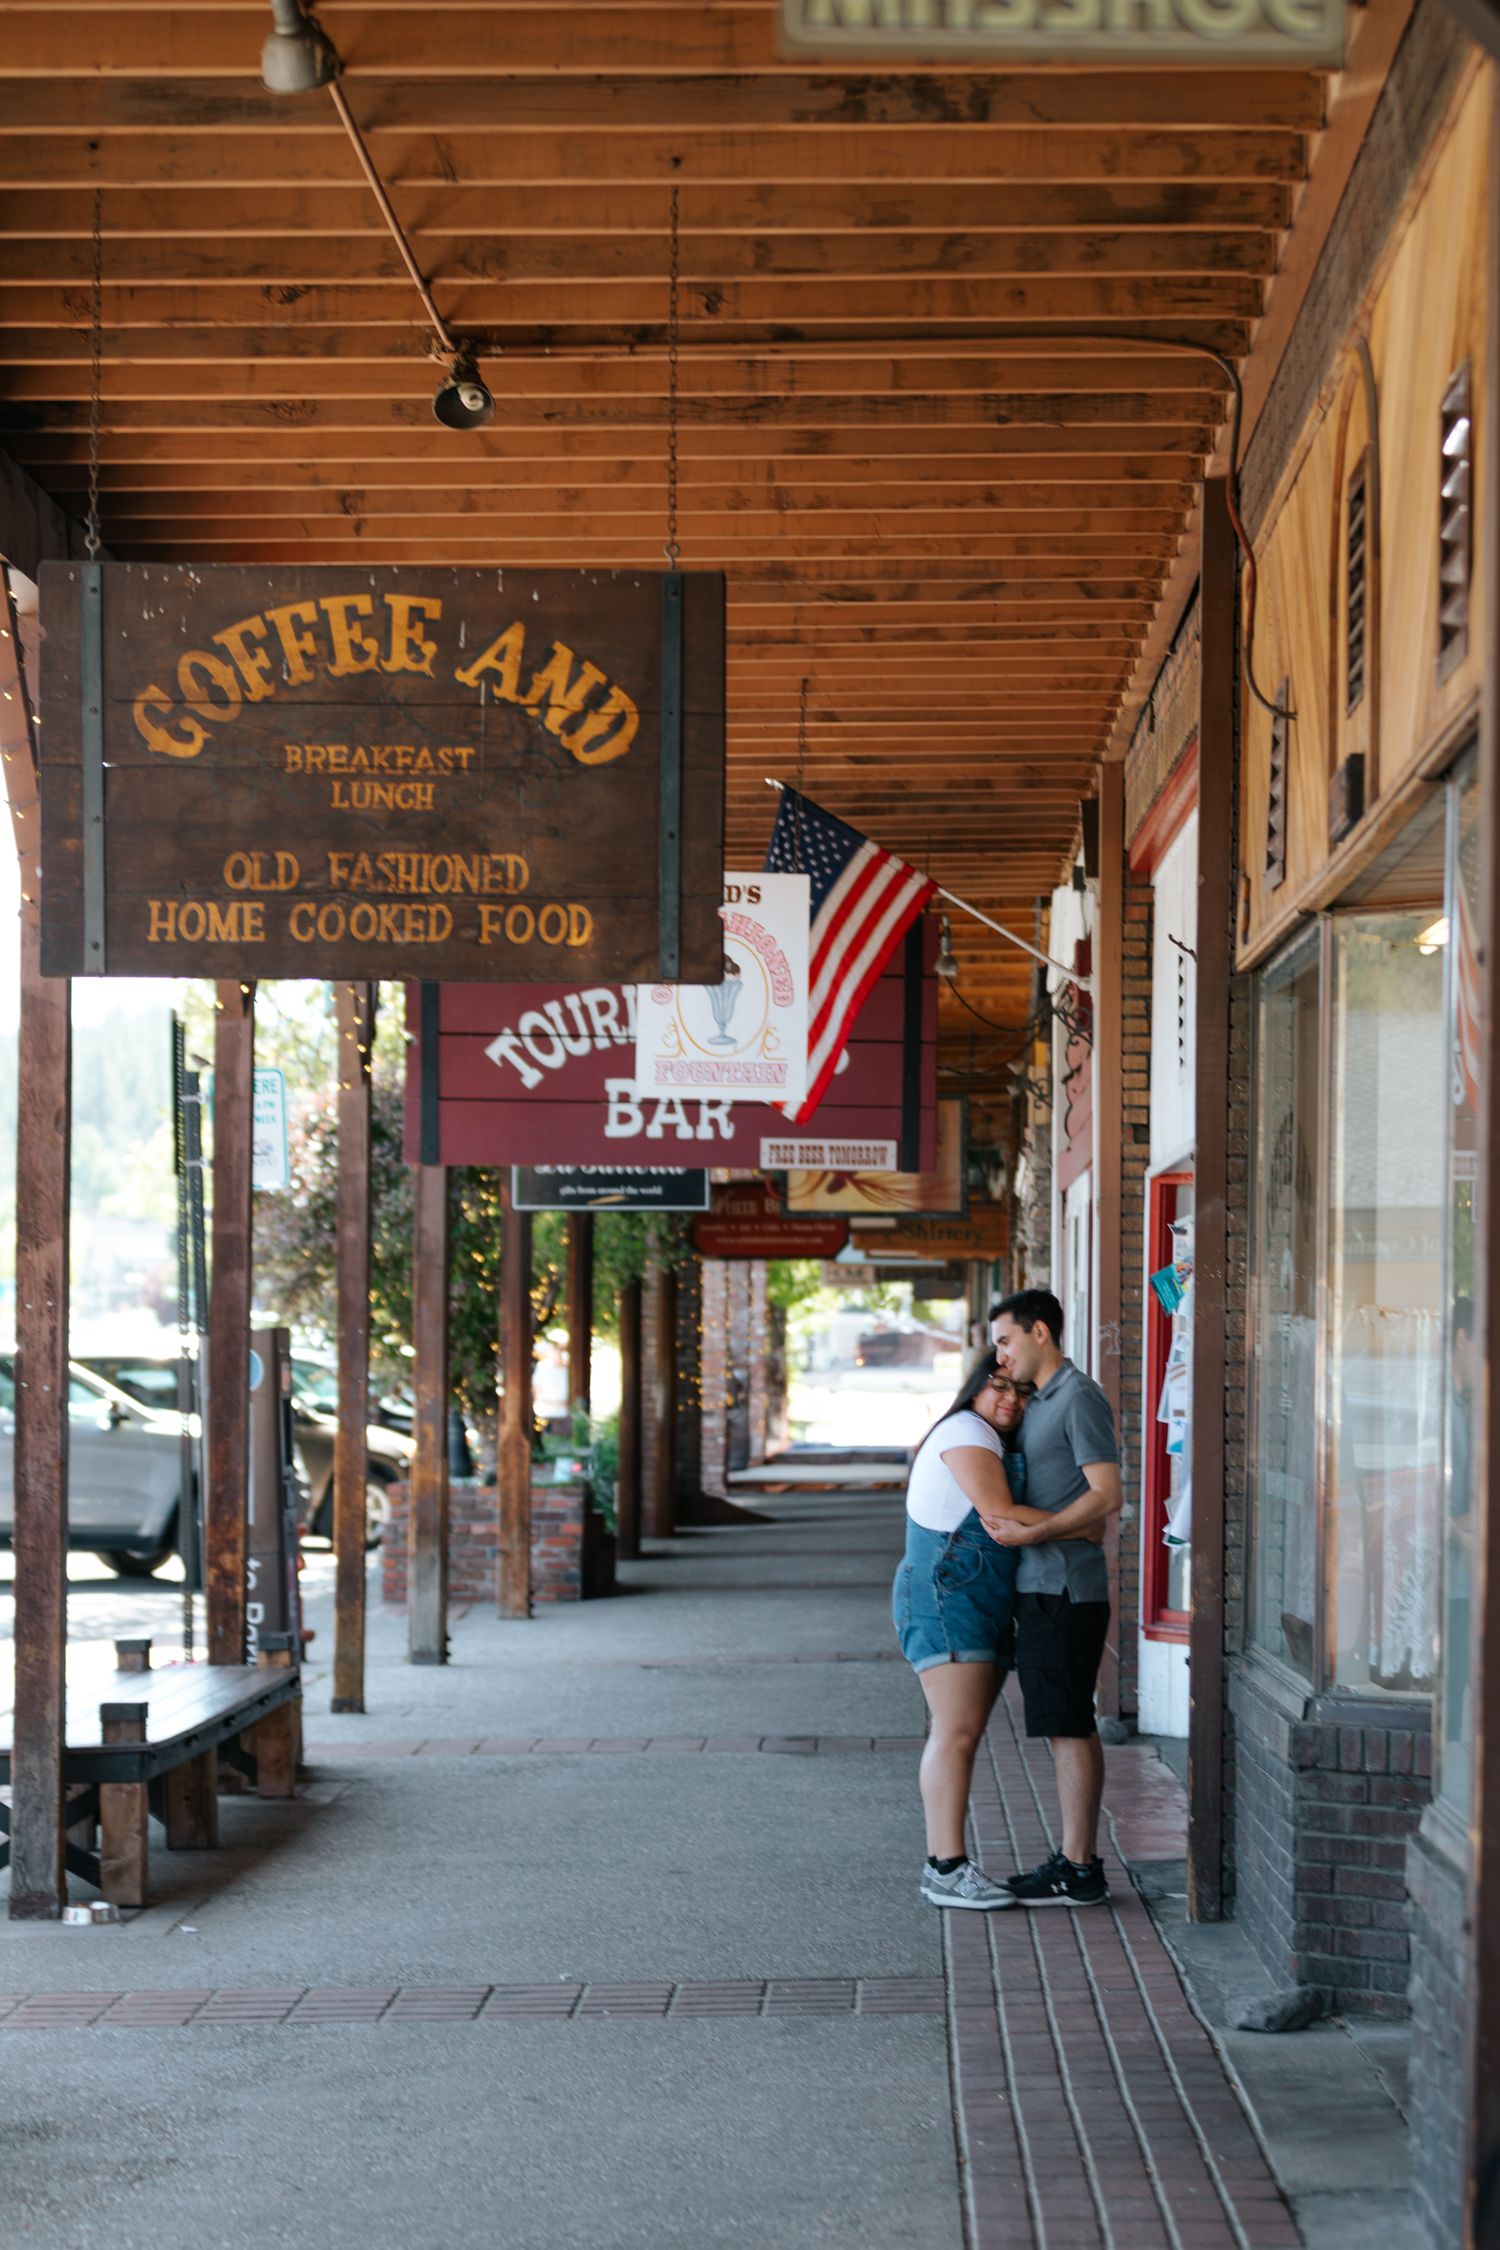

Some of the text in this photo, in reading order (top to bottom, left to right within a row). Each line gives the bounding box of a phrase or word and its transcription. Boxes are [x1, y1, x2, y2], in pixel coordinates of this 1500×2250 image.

[132, 594, 640, 766] COFFEE AND
[284, 745, 476, 775] BREAKFAST
[330, 781, 435, 810] LUNCH
[223, 852, 529, 894] OLD FASHIONED
[147, 900, 594, 947] HOME COOKED FOOD
[654, 1060, 788, 1084] FOUNTAIN
[604, 1077, 735, 1140] BAR
[768, 1144, 888, 1167] FREE BEER TOMORROW
